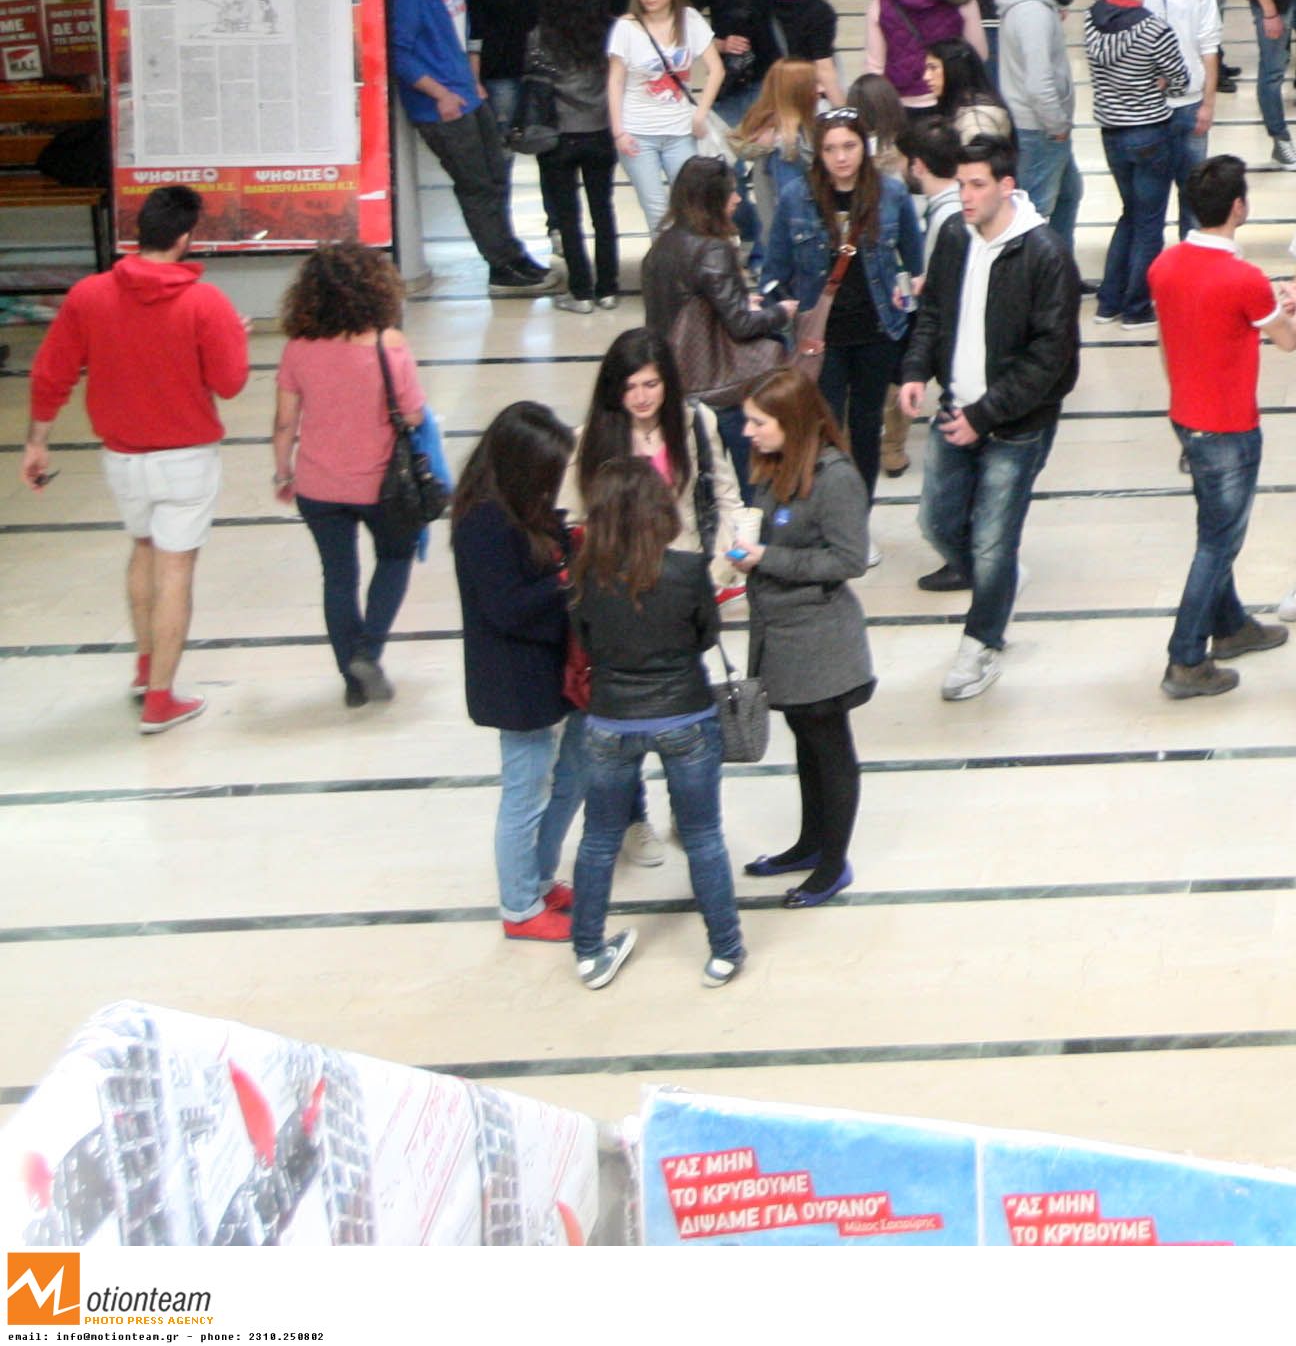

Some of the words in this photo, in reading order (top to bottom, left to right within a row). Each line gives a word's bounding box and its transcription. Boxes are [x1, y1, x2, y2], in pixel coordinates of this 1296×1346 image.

[133, 170, 200, 182] ΨΗΦΙΣΕ
[255, 169, 321, 181] ΨΗΦΙΣΕ
[706, 1150, 753, 1175] ΜΗΝ
[672, 1188, 697, 1207] ΤΟ
[703, 1174, 809, 1204] ΚΡΥΒΟΥΜΕ
[1049, 1195, 1094, 1214] ΜΗΝ
[680, 1206, 760, 1235] ΔΙΨΑΜΕ
[765, 1203, 798, 1224] ΓΙΑ
[1013, 1225, 1039, 1245] ΤΟ
[1043, 1219, 1152, 1244] ΚΡΥΒΟΥΜΕ
